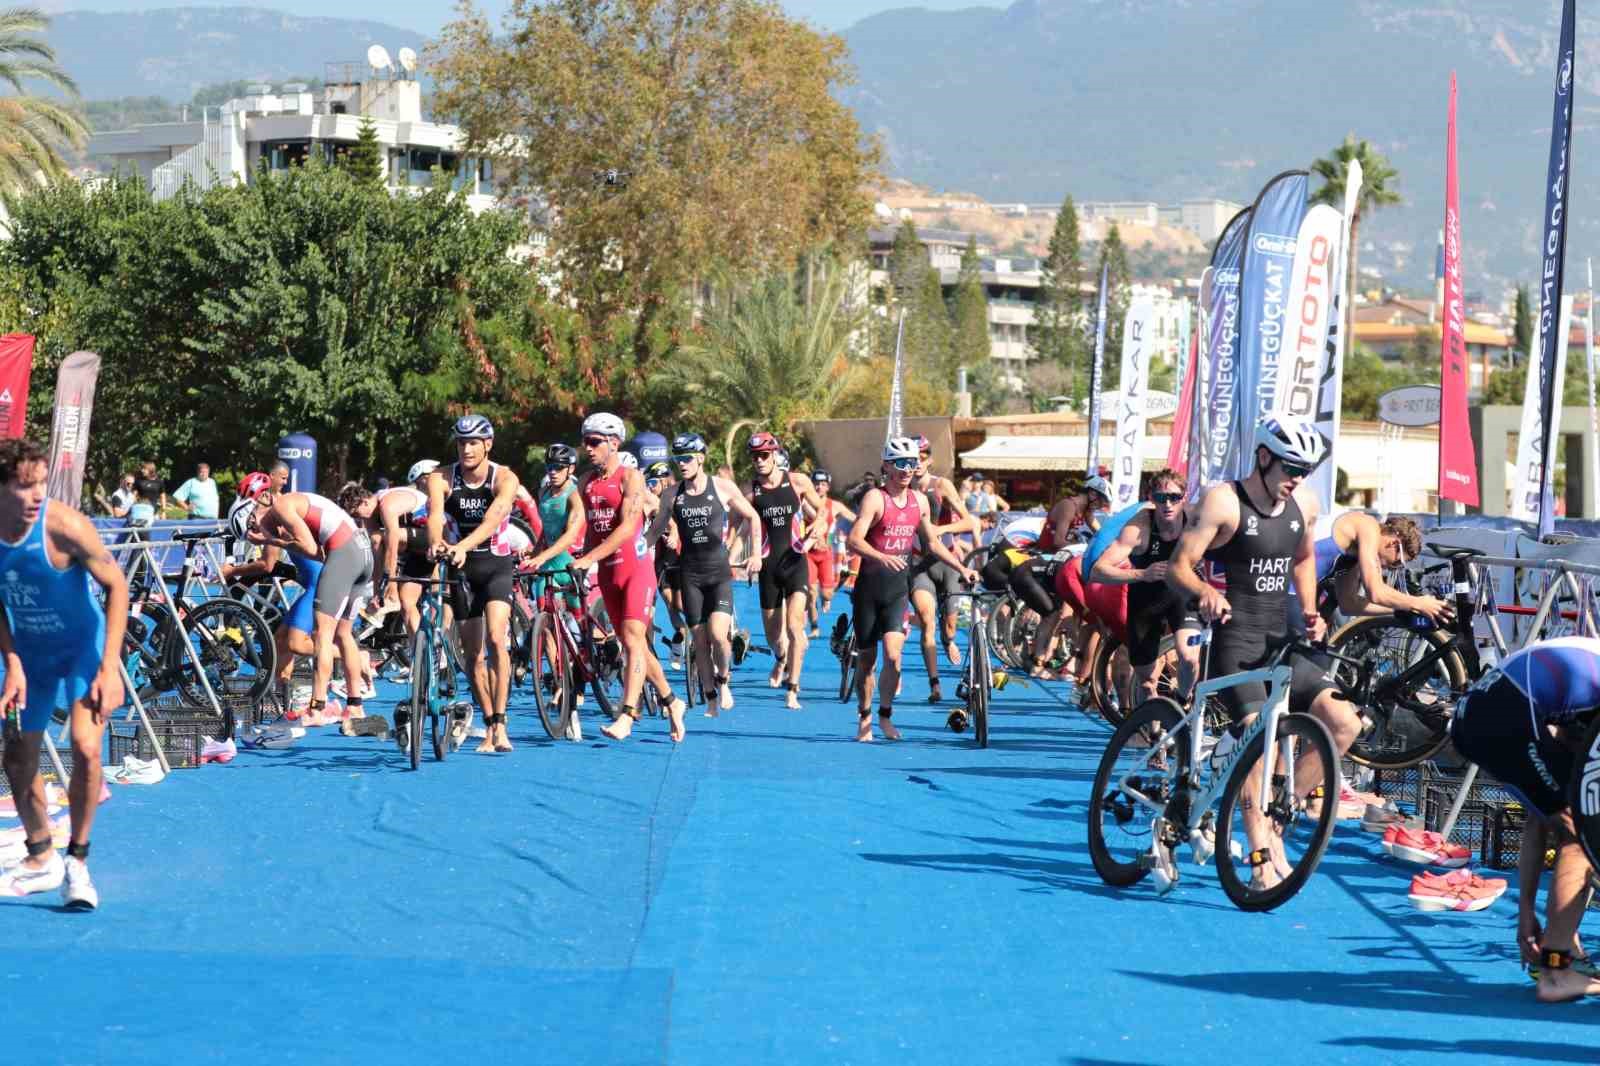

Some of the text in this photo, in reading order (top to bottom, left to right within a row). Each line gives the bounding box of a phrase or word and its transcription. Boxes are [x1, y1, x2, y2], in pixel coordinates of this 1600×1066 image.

[1290, 234, 1329, 417] OR TOTO
[465, 510, 485, 519] CRO
[681, 505, 713, 518] DOWNEY
[593, 520, 612, 533] CZE
[687, 517, 709, 528] GBR
[773, 516, 785, 528] RUS
[885, 538, 908, 551] LAT
[1250, 556, 1292, 574] HART
[1255, 576, 1285, 592] GBR
